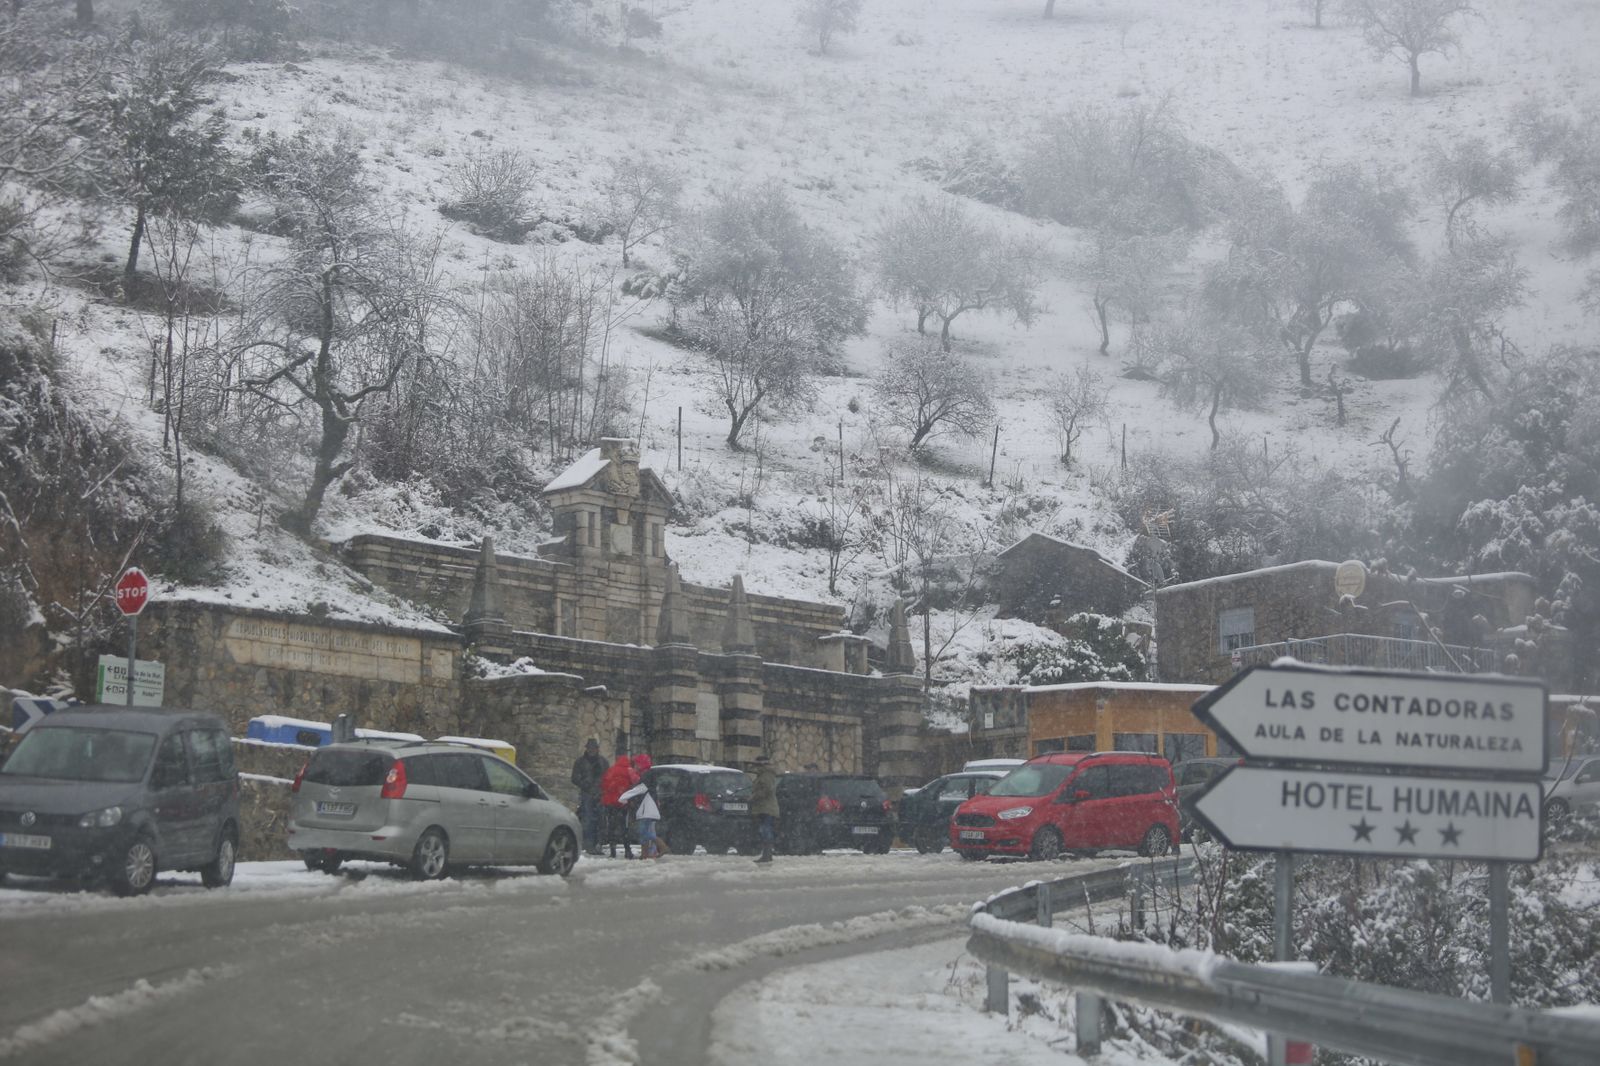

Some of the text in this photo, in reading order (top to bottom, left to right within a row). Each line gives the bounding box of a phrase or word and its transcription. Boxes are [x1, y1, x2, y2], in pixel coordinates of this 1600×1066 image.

[117, 585, 146, 599] STOP
[1265, 688, 1515, 722] LAS CONTADORAS
[1255, 723, 1523, 752] AULA DE LA NATURALEZA
[1281, 780, 1535, 820] HOTEL HUMAINA
